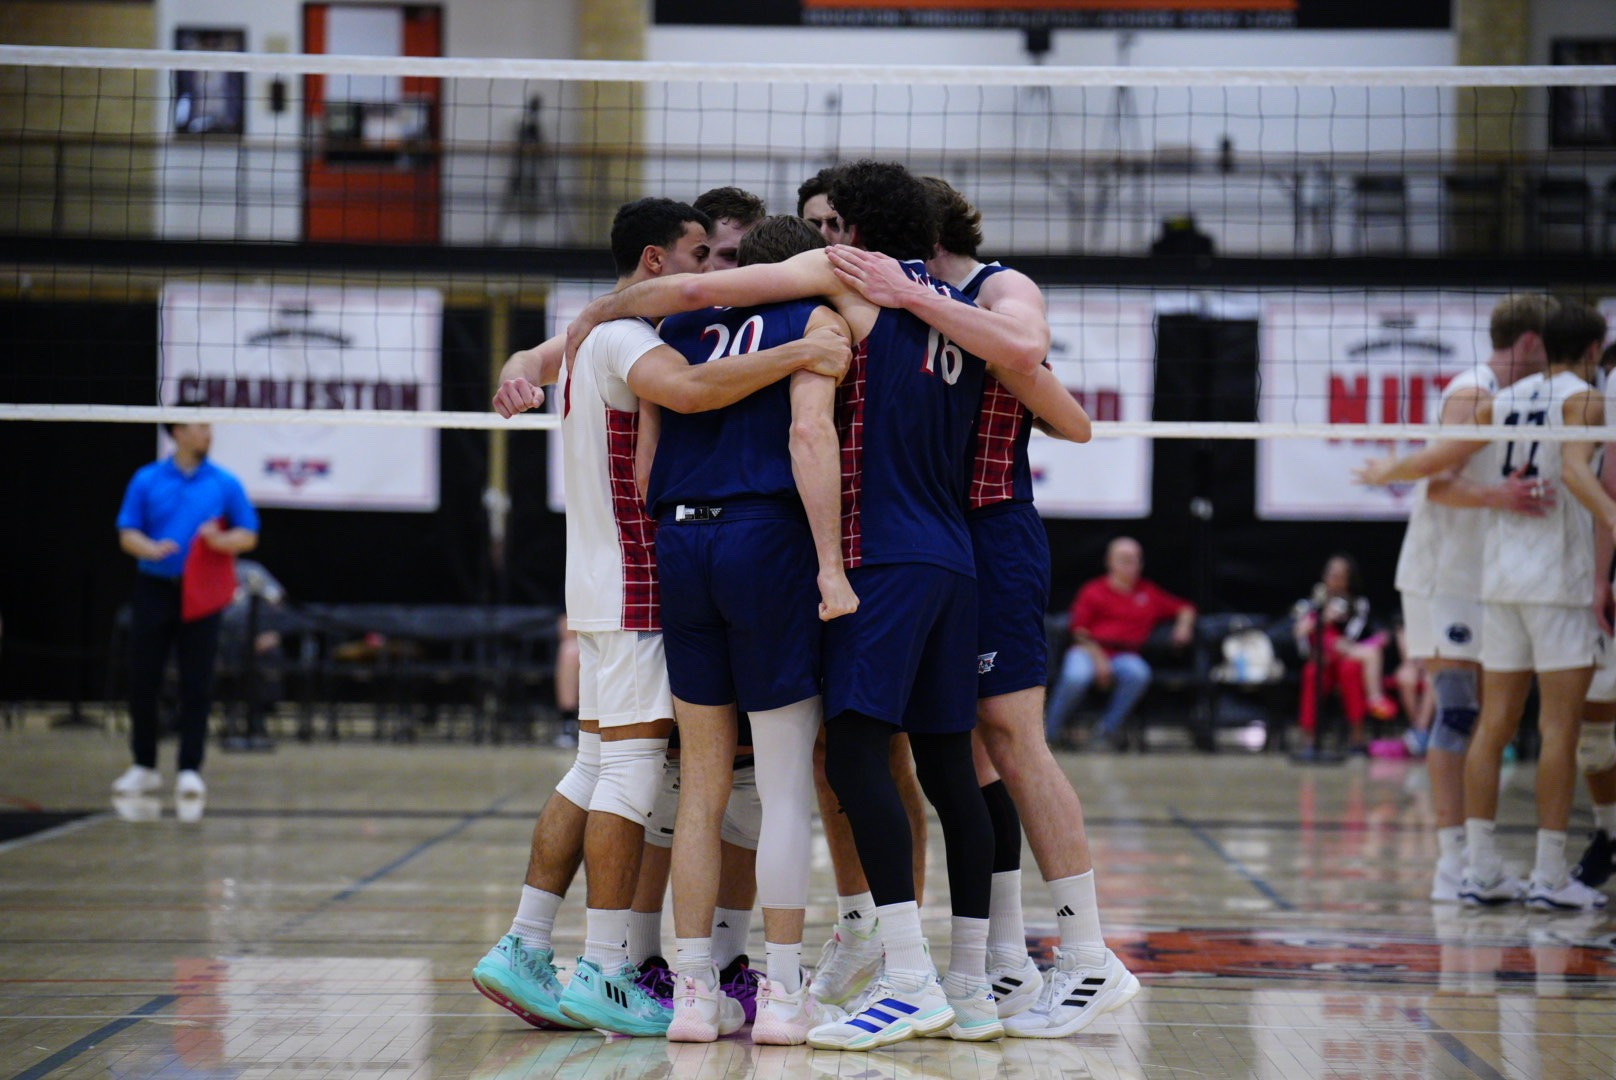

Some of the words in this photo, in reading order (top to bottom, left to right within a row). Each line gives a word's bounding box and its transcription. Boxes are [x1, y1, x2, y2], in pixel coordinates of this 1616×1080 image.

[700, 315, 764, 362] 20
[920, 327, 963, 386] 16
[177, 376, 419, 410] CHARLESTON
